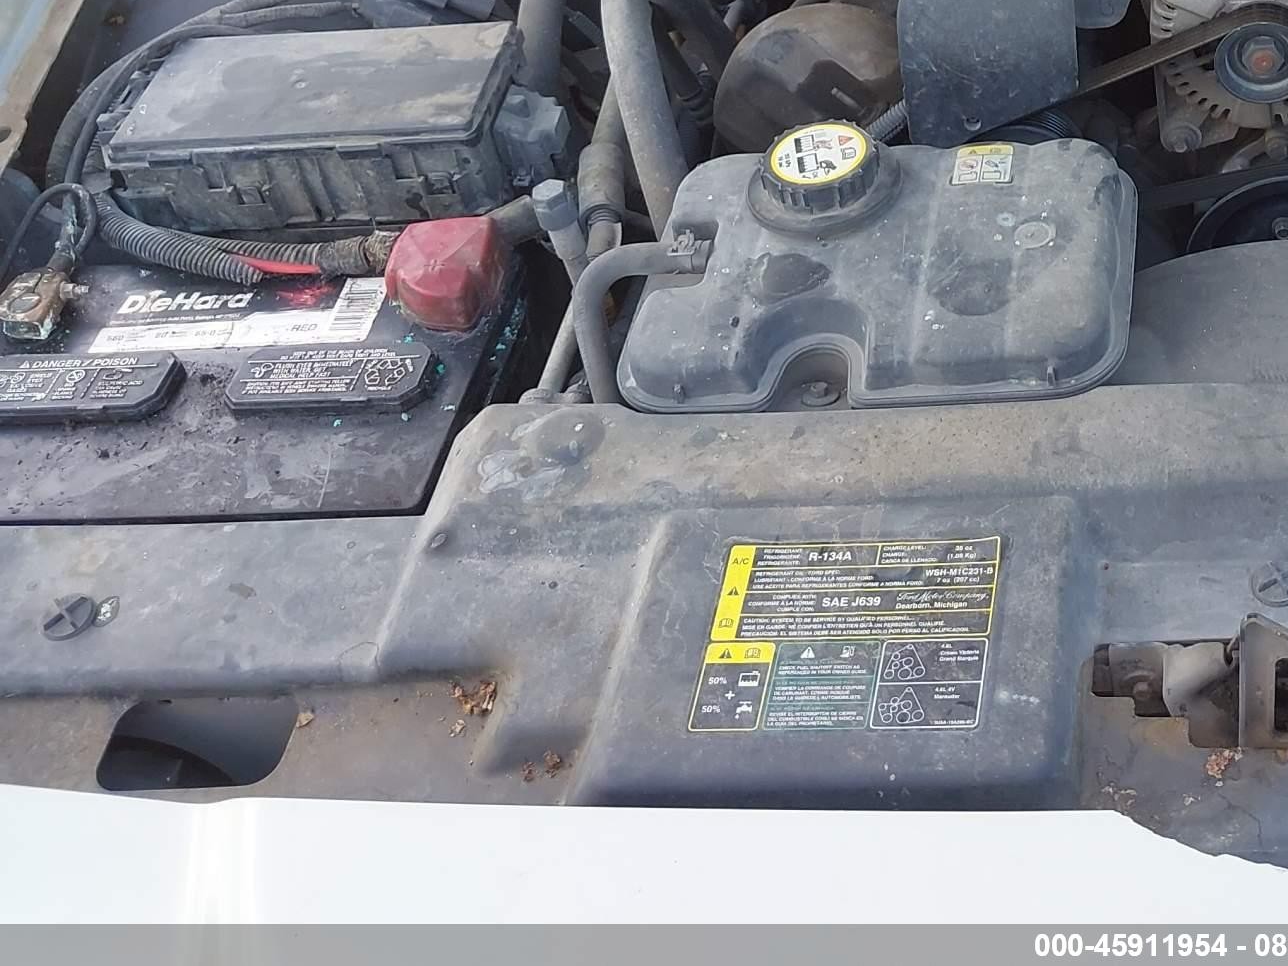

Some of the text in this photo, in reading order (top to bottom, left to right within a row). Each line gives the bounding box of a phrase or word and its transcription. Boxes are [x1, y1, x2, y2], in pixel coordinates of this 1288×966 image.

[32, 360, 81, 368] DANGER
[93, 358, 138, 366] POISON
[809, 552, 852, 561] R-134A
[918, 591, 944, 602] Motor
[822, 596, 881, 607] SAE J639
[708, 676, 727, 685] 50%
[702, 705, 720, 713] 50%
